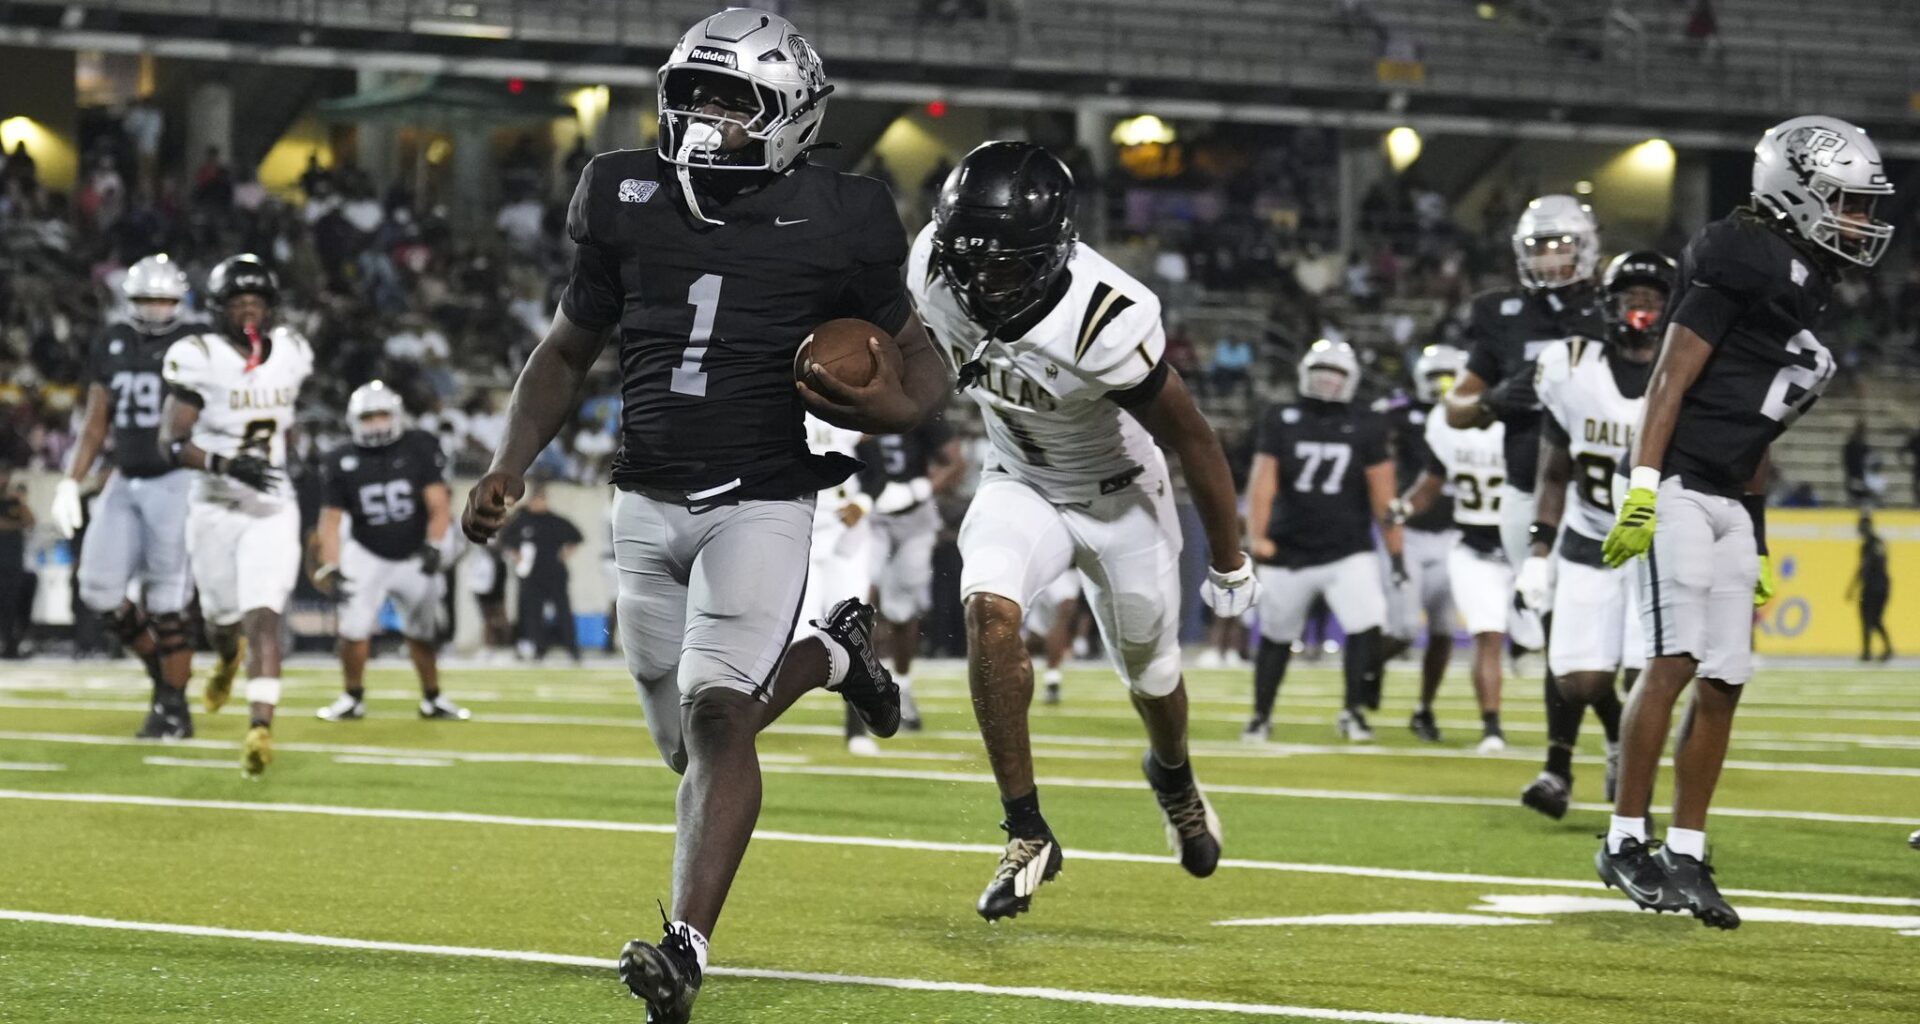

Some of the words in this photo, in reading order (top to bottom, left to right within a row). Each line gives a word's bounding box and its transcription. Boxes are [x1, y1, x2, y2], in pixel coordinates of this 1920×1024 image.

[691, 50, 735, 64] Riddell
[970, 237, 984, 246] F7
[669, 273, 723, 397] 1
[111, 371, 160, 428] 79
[951, 344, 1058, 412] DLLAS
[1584, 418, 1635, 447] DALL
[1294, 441, 1351, 494] 77
[359, 479, 414, 526] 56
